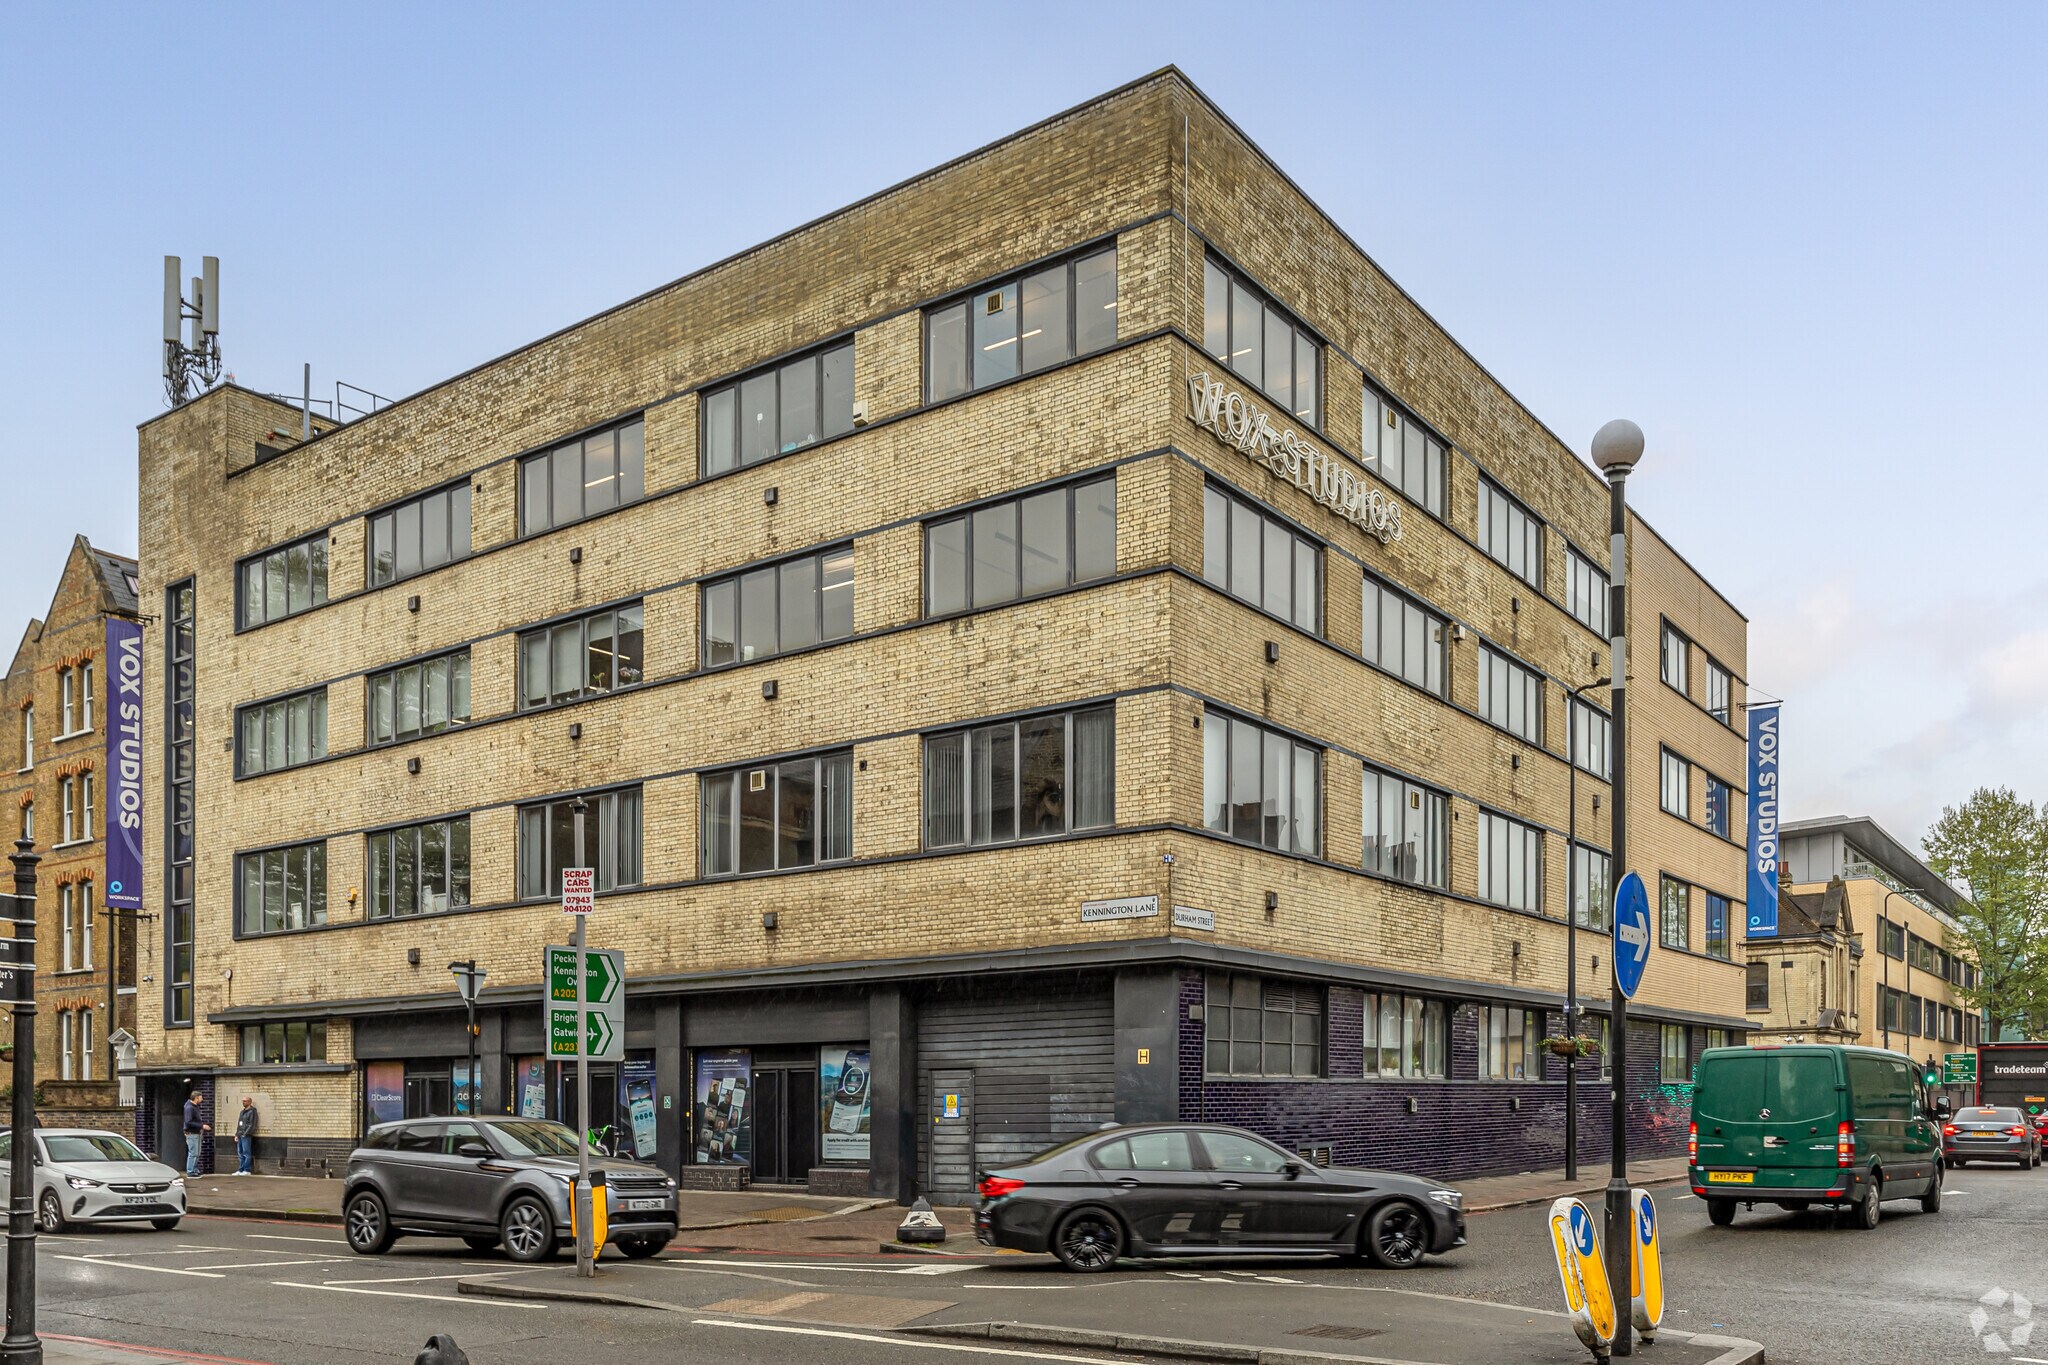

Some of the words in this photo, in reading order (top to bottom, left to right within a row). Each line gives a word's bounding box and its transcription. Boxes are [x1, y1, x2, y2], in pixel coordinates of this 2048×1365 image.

[1189, 371, 1268, 460] VOX
[1270, 428, 1403, 544] STUDIOS
[120, 636, 140, 697] VOX
[1758, 716, 1777, 767] VOX
[120, 701, 140, 830] STUDIOS
[1758, 772, 1777, 874] STUDIOS
[564, 870, 592, 878] SCRAP
[1083, 906, 1133, 917] KENNINGTON
[1136, 904, 1156, 912] LANE
[1176, 912, 1197, 923] DURHAM
[1197, 917, 1213, 926] STREET
[554, 953, 588, 965] Peckh
[554, 966, 598, 977] Kenniton
[554, 1012, 578, 1024] Bright
[554, 1027, 578, 1036] Gatwi
[1139, 1050, 1148, 1063] H
[1994, 1065, 2046, 1074] tradeteam
